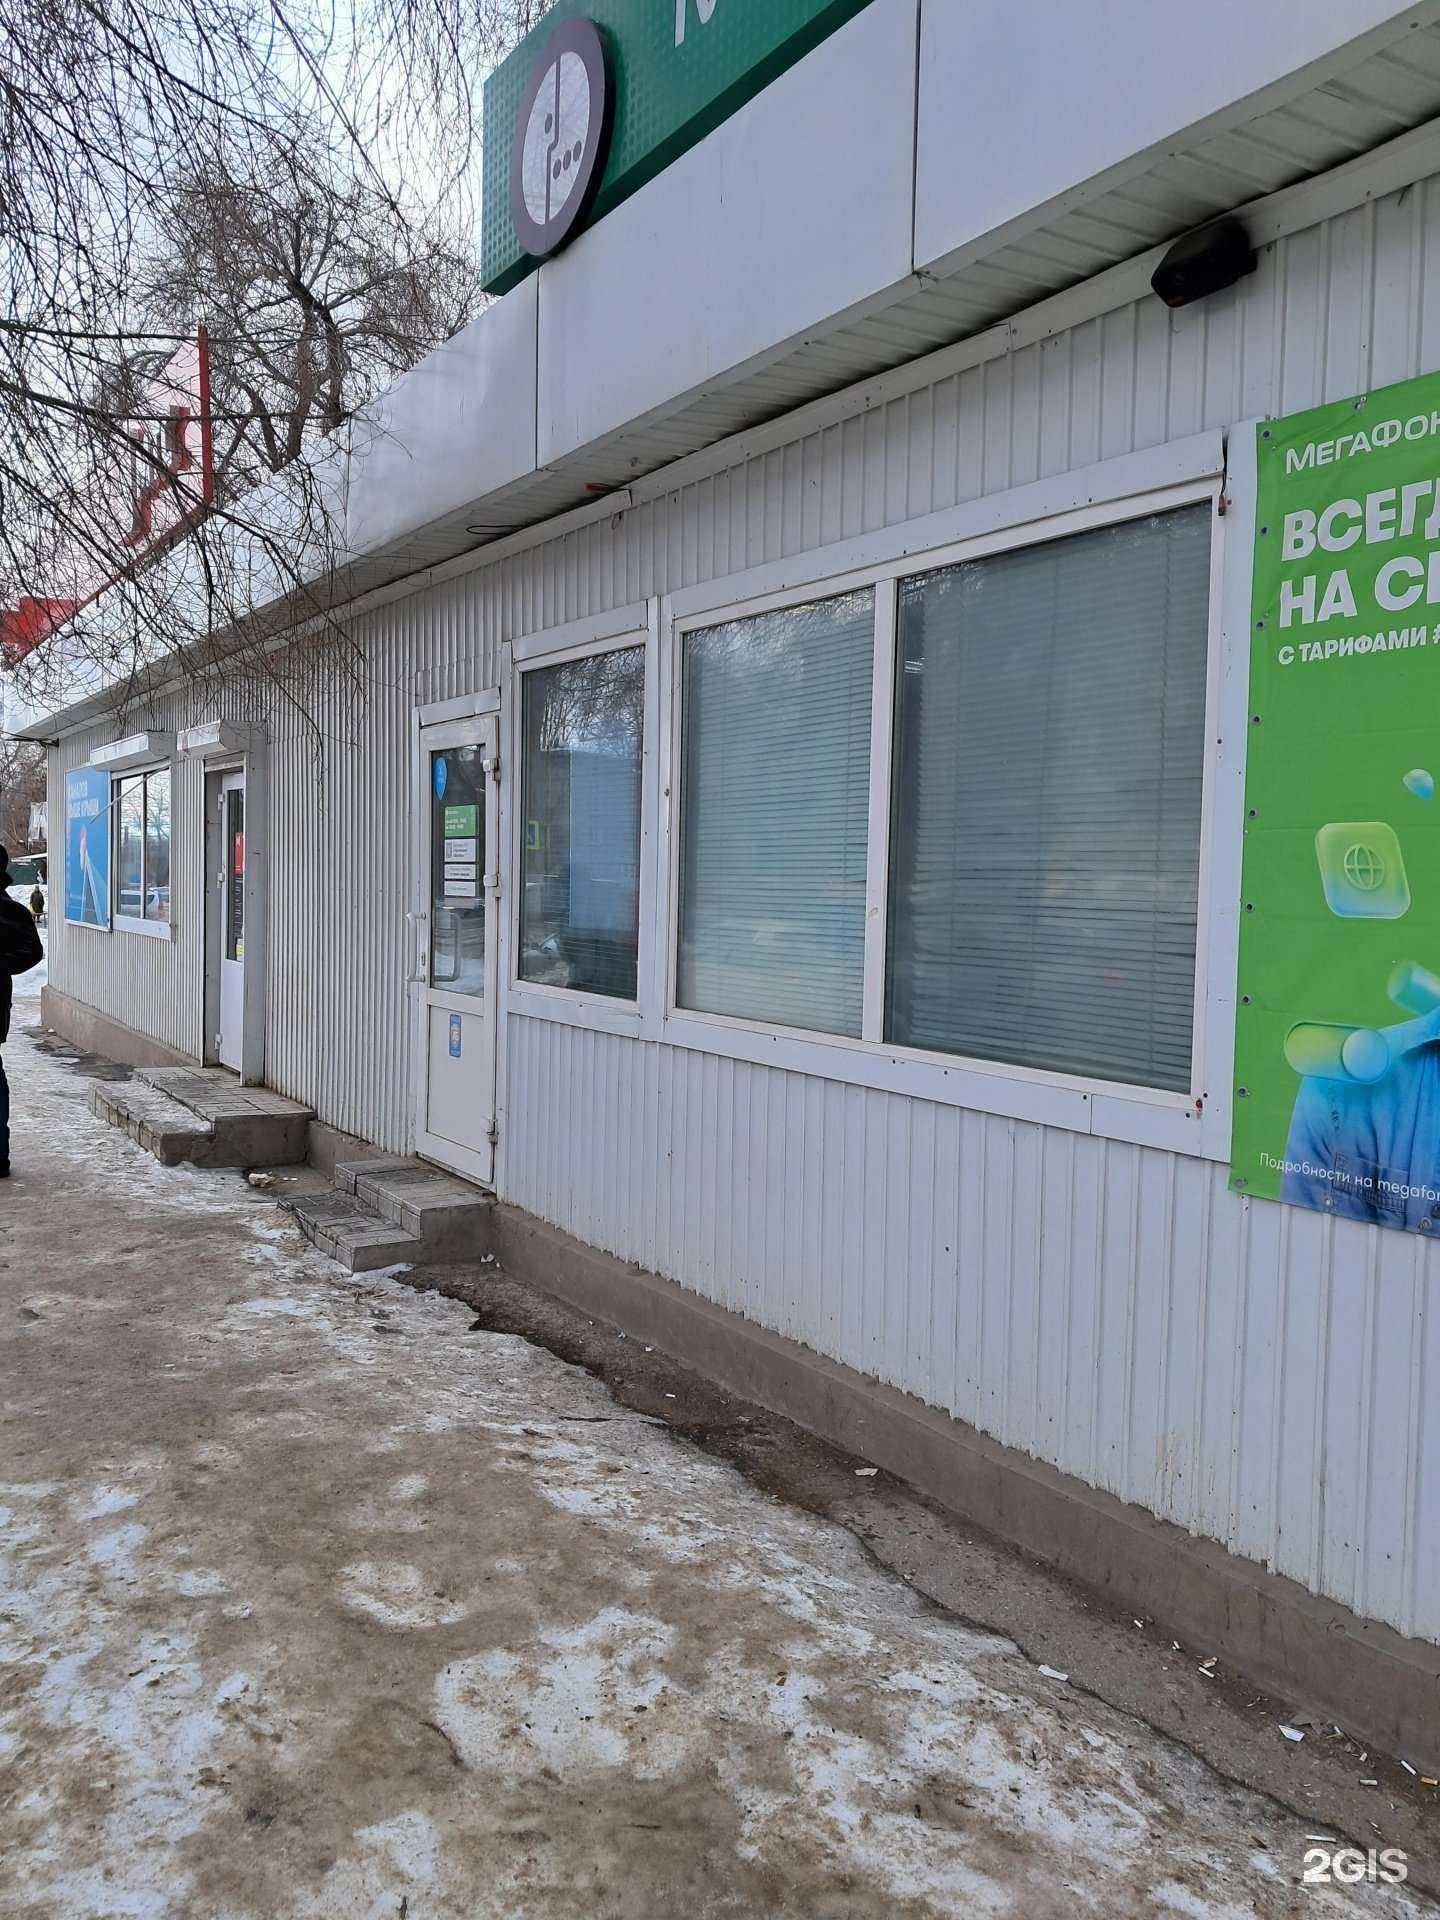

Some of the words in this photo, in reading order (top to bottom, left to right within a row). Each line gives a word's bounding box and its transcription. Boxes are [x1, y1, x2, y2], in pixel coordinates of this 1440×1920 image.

[1279, 569, 1358, 628] НА
[1278, 646, 1295, 665] С
[1299, 625, 1427, 662] ТАРИФАМИ
[1259, 1152, 1350, 1182] Подробности
[1355, 1175, 1373, 1188] на
